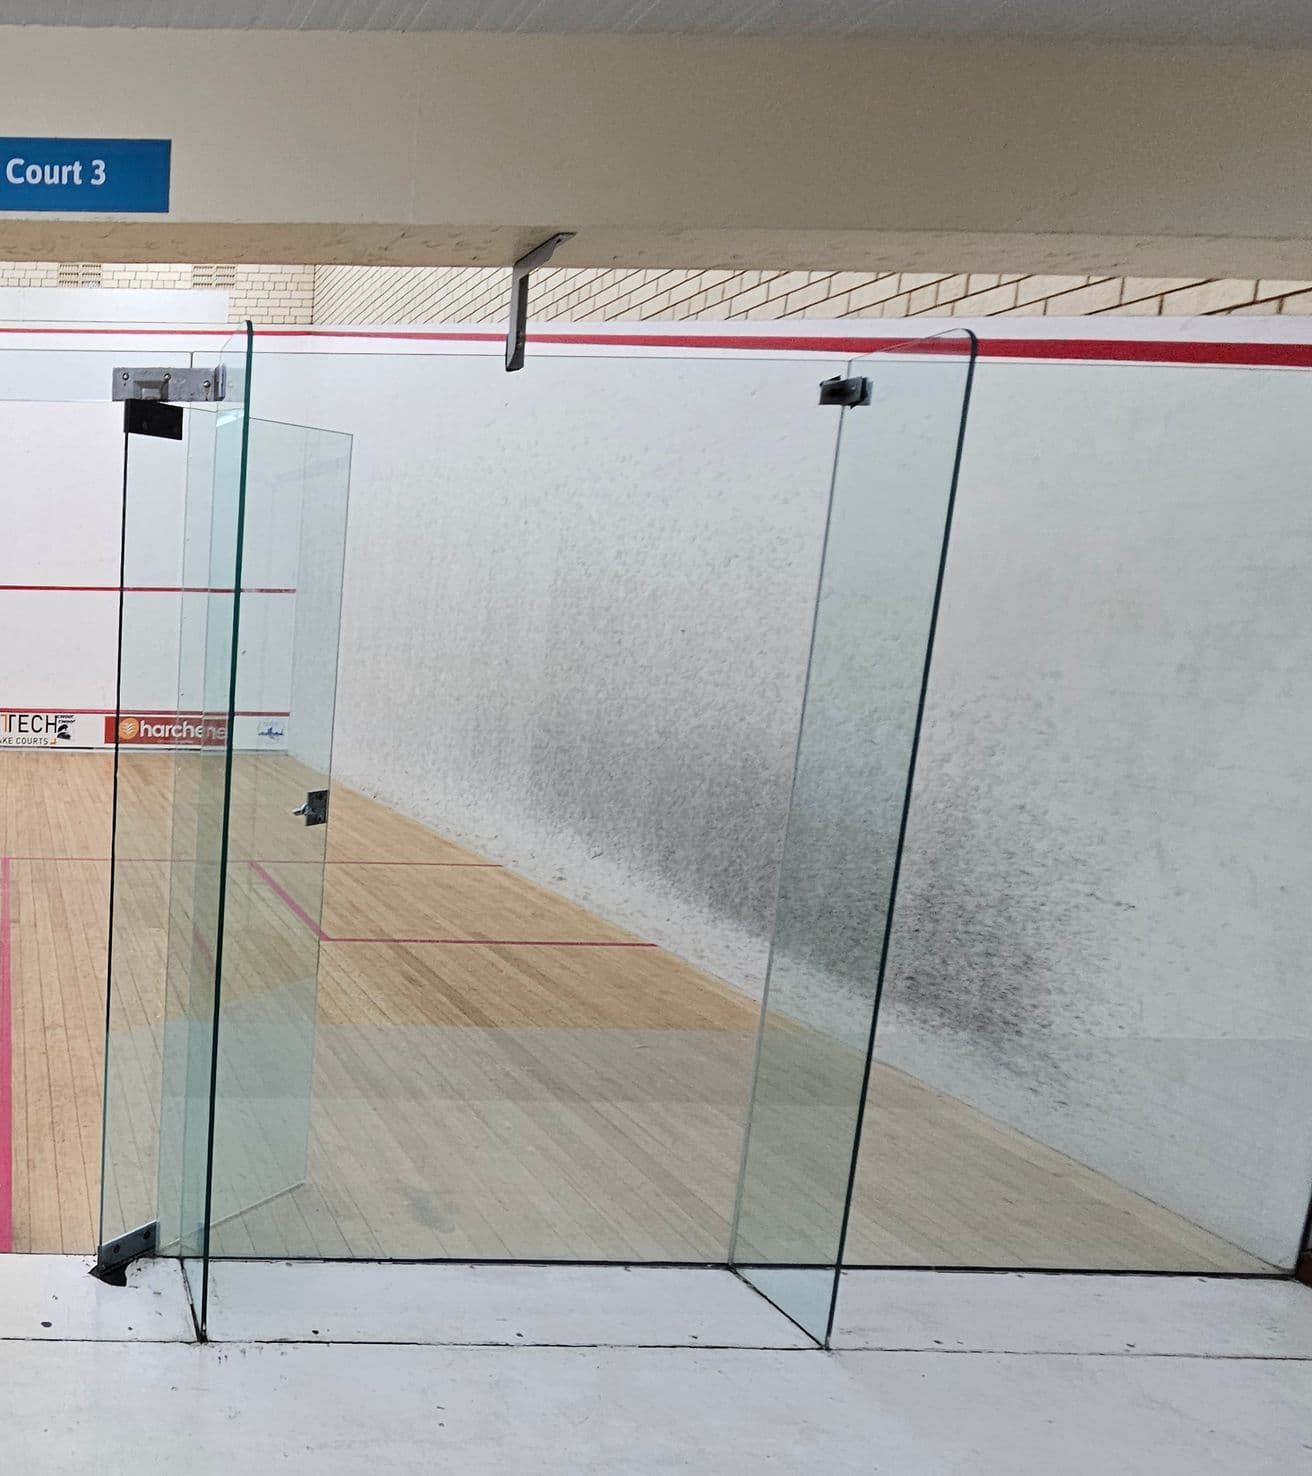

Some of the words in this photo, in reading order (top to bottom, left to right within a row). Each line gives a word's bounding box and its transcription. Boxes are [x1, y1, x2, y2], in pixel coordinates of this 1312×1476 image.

[5, 158, 83, 185] Court
[90, 159, 107, 186] 3
[15, 737, 49, 746] COURTS
